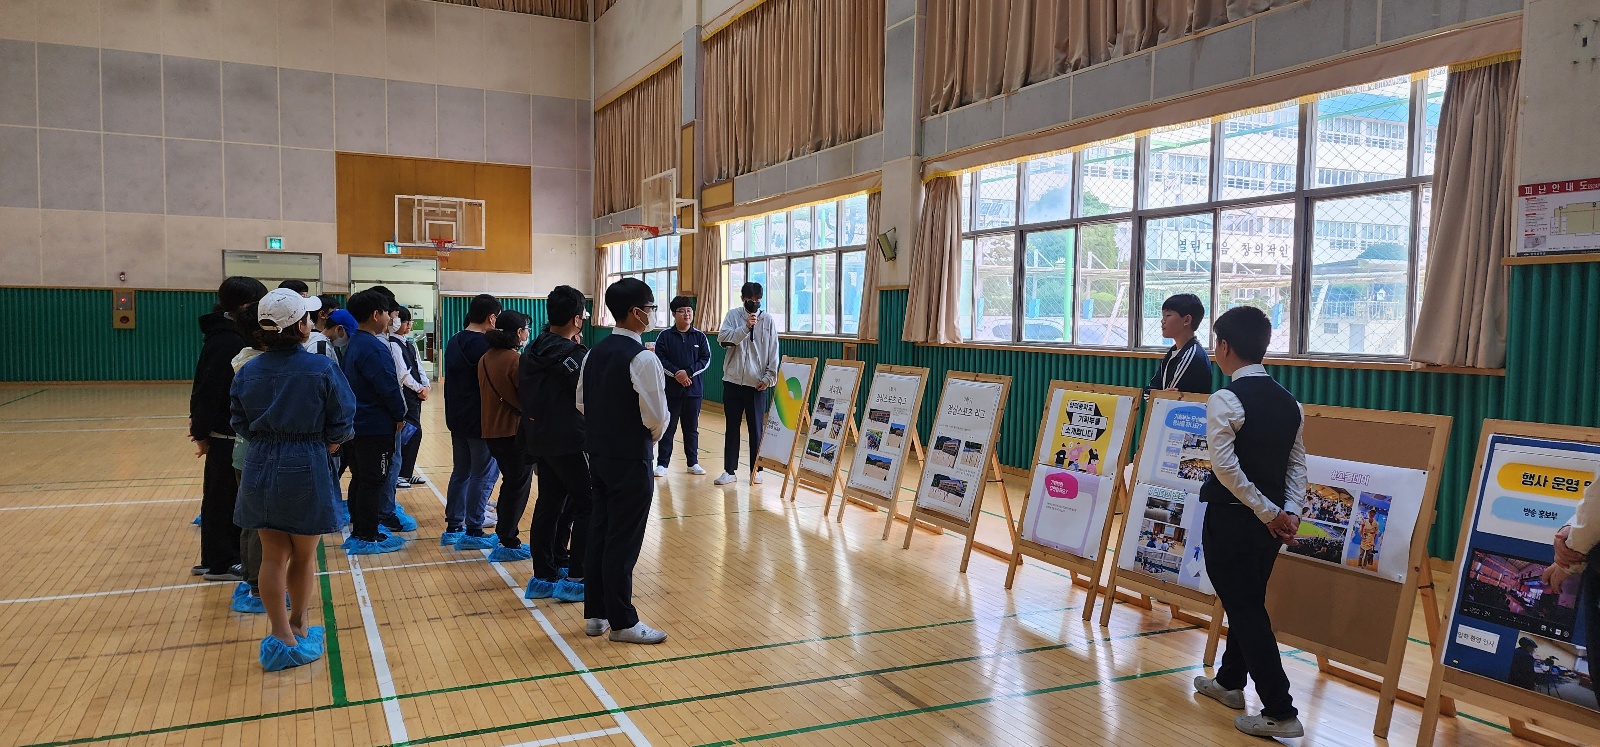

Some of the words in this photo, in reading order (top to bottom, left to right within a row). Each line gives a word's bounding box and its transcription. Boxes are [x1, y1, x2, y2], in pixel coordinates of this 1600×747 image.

[1242, 242, 1289, 258] 창의적인
[1064, 426, 1095, 438] 소개합니다
[1521, 472, 1549, 488] 행사
[1551, 476, 1580, 492] 운영
[1523, 507, 1537, 518] 방송
[1538, 510, 1558, 521] 홍보부
